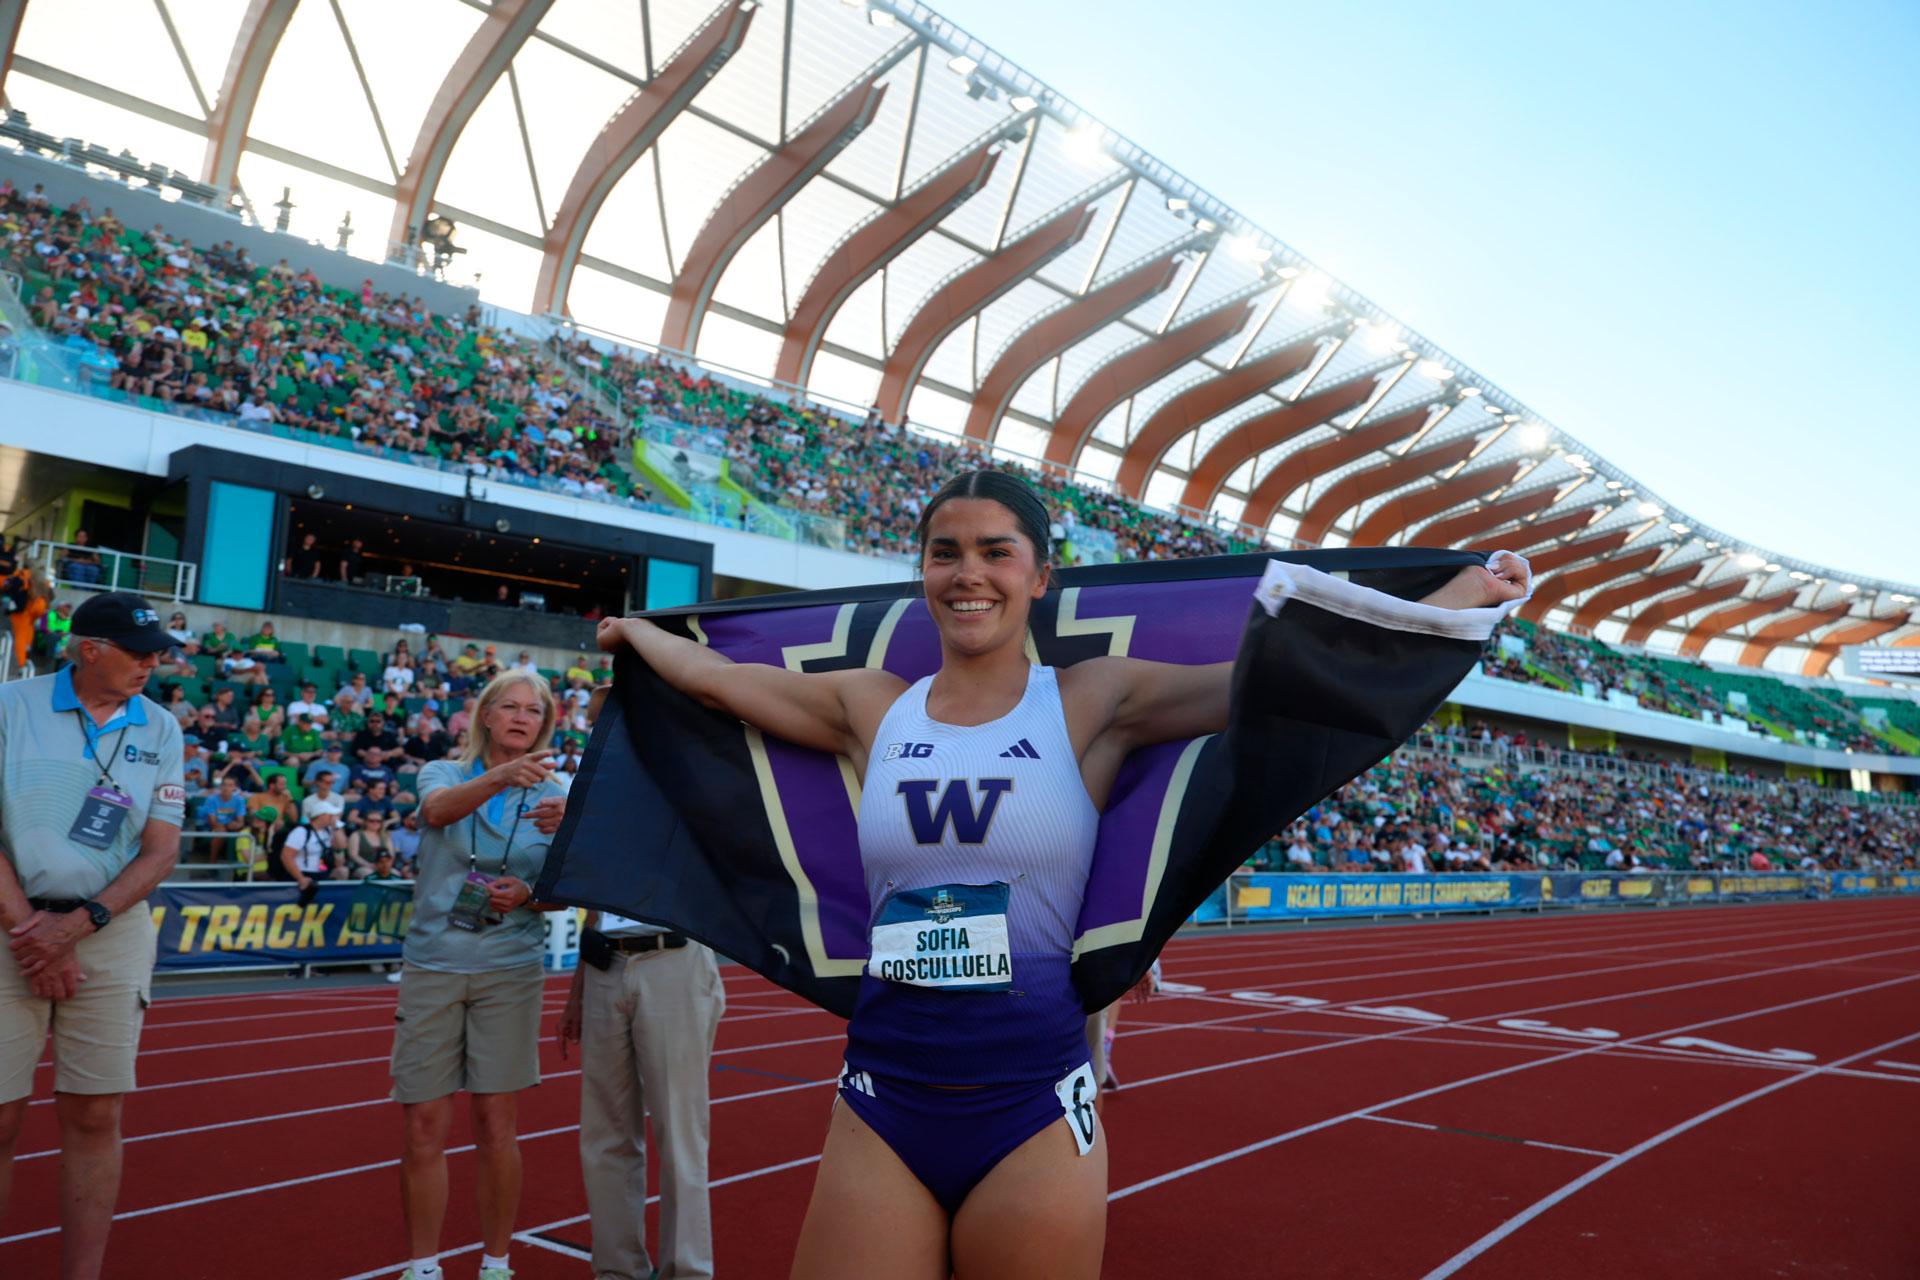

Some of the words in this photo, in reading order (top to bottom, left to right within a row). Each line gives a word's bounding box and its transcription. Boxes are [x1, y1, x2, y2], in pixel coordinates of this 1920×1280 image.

[896, 777, 1014, 846] W
[1287, 885, 1320, 908] NCAA
[1340, 883, 1376, 906] TRACK
[1379, 883, 1401, 904] AND
[1404, 882, 1431, 904] FIELD
[1434, 880, 1510, 903] CHAMPIONSHIPS
[178, 903, 335, 953] TRACK
[917, 927, 970, 952] SOFIA
[881, 953, 1010, 981] COSCULLUELA
